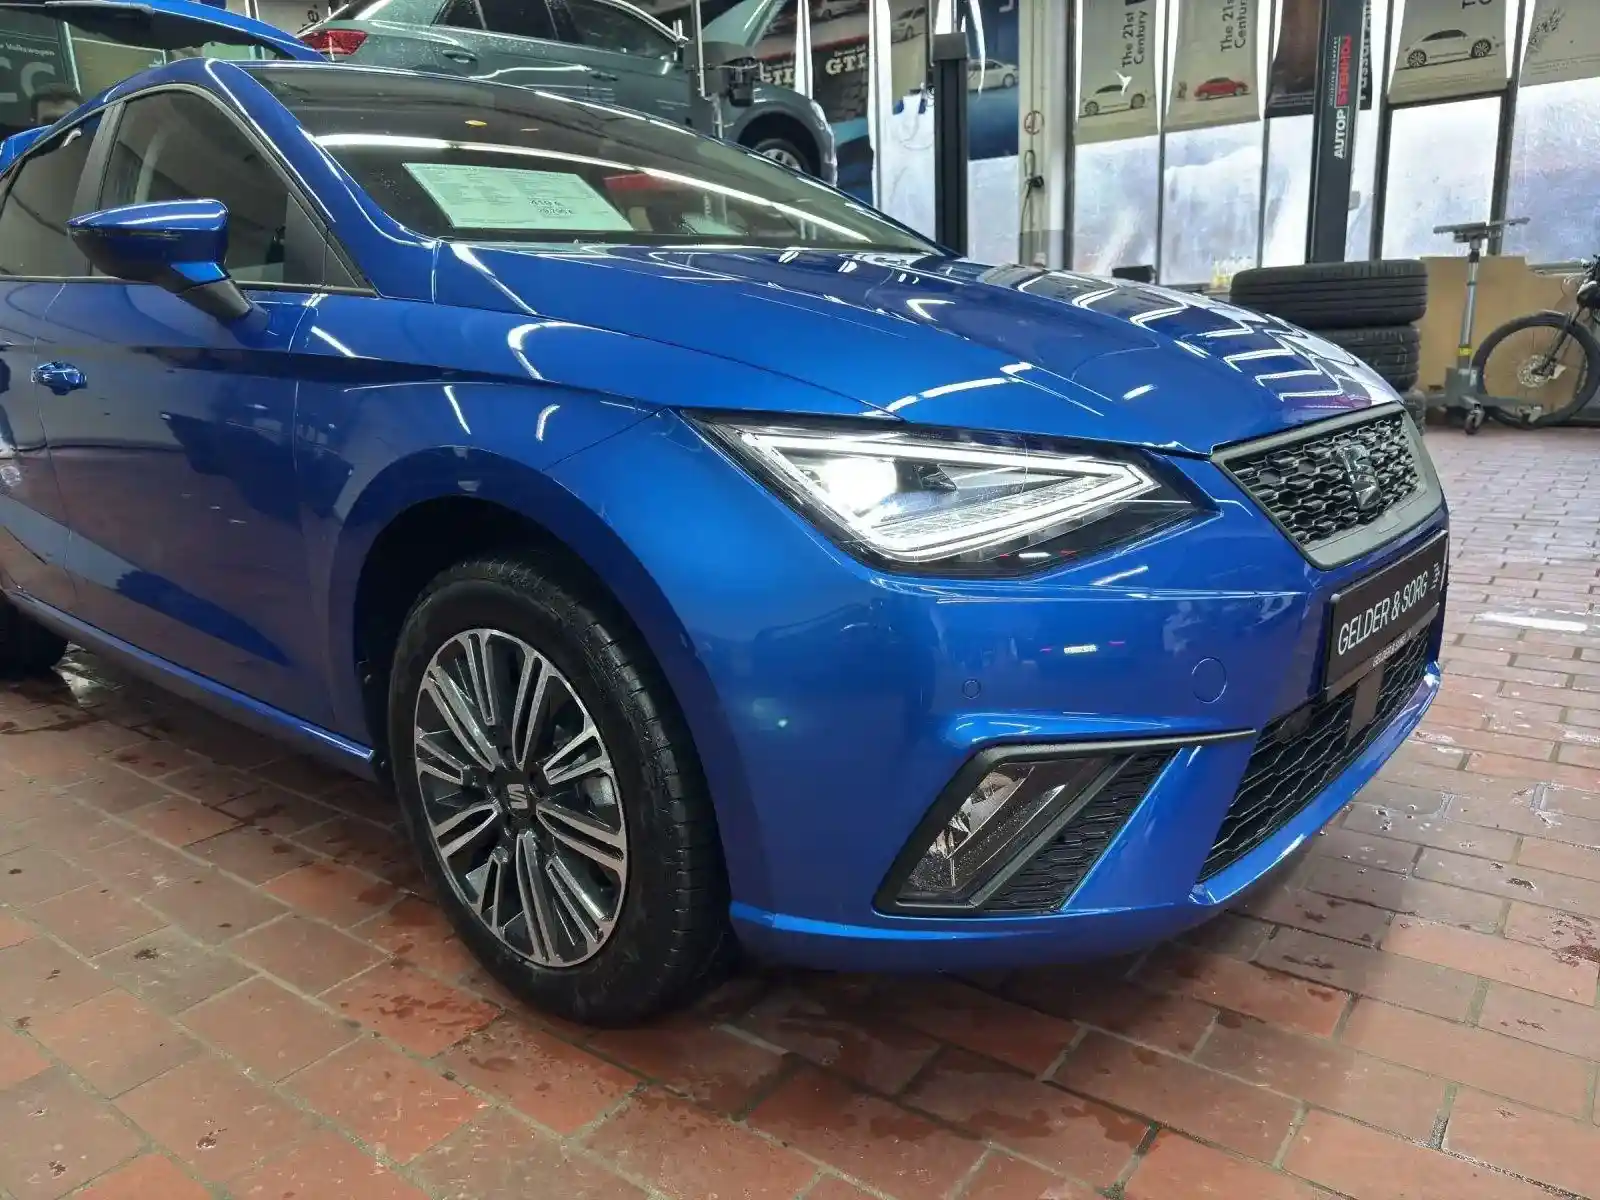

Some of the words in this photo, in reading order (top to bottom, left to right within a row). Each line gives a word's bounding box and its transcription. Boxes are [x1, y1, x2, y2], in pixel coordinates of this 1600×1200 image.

[1122, 45, 1132, 67] The
[1134, 10, 1148, 65] Century
[1220, 26, 1233, 51] The
[825, 53, 867, 75] GTI
[1334, 108, 1346, 159] AUTOP
[1338, 597, 1391, 656] GELDER
[1391, 590, 1401, 621] &
[1402, 570, 1429, 613] SORG
